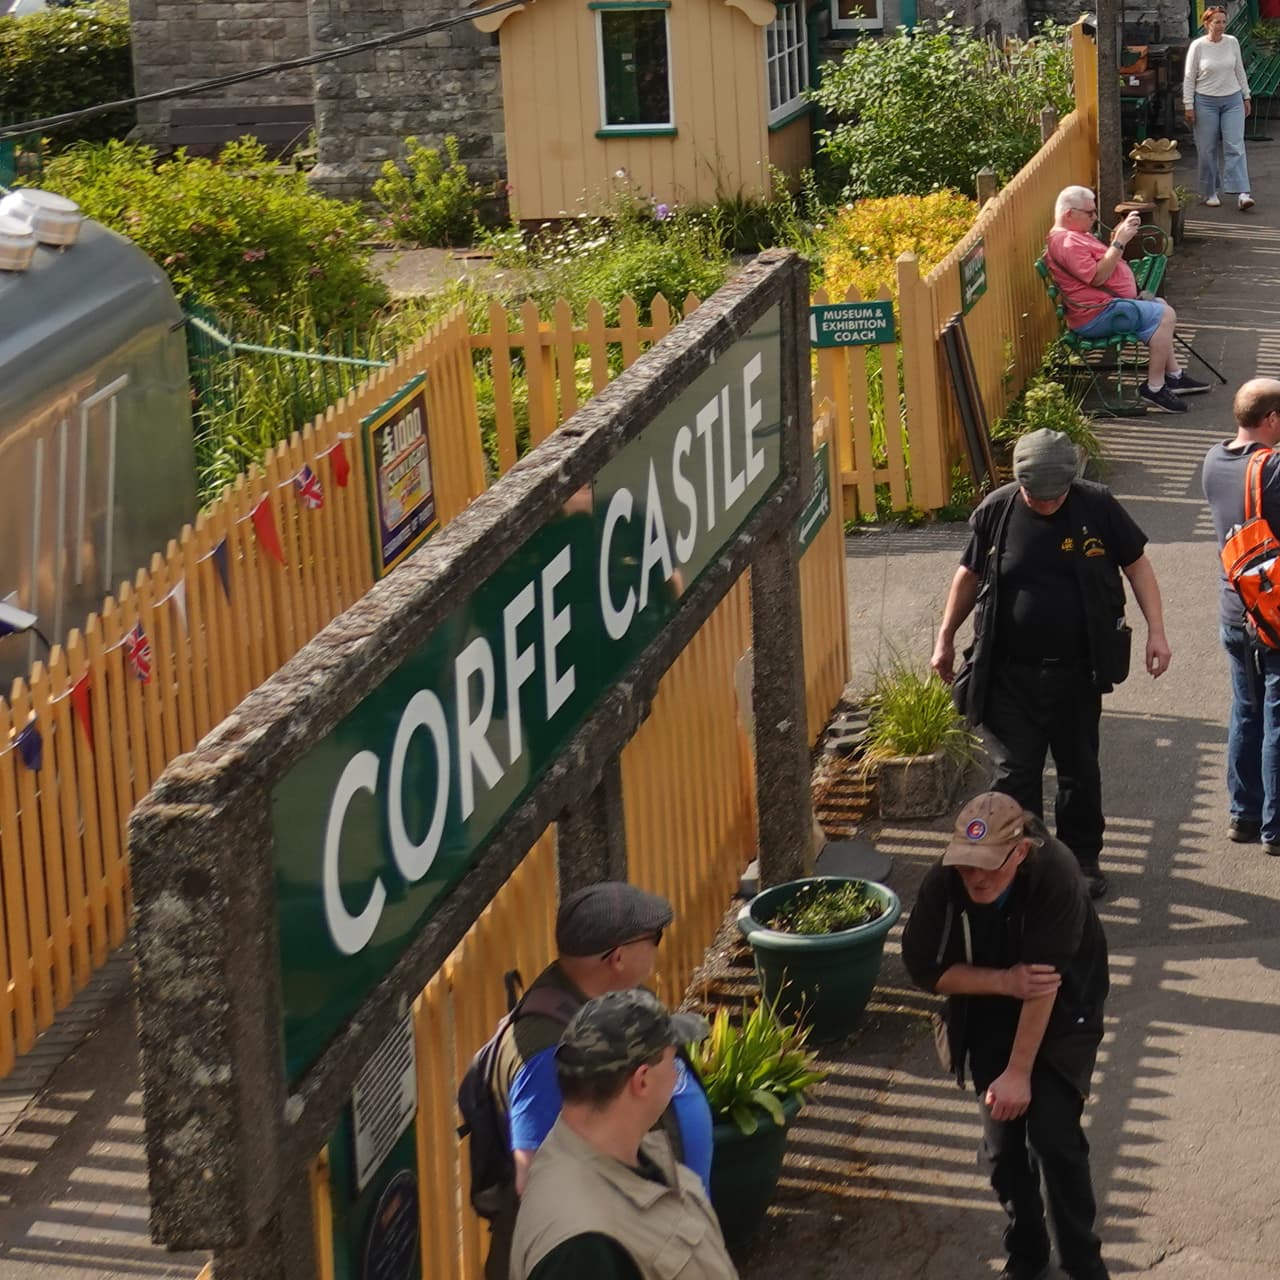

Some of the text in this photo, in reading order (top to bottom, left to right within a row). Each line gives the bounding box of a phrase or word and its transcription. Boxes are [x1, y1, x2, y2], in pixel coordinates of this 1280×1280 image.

[823, 308, 884, 320] MUSEUM &
[822, 318, 887, 331] EXHIBITION
[834, 330, 877, 342] COACH
[383, 406, 422, 467] £1000
[323, 351, 768, 957] CORFE CASTLE
